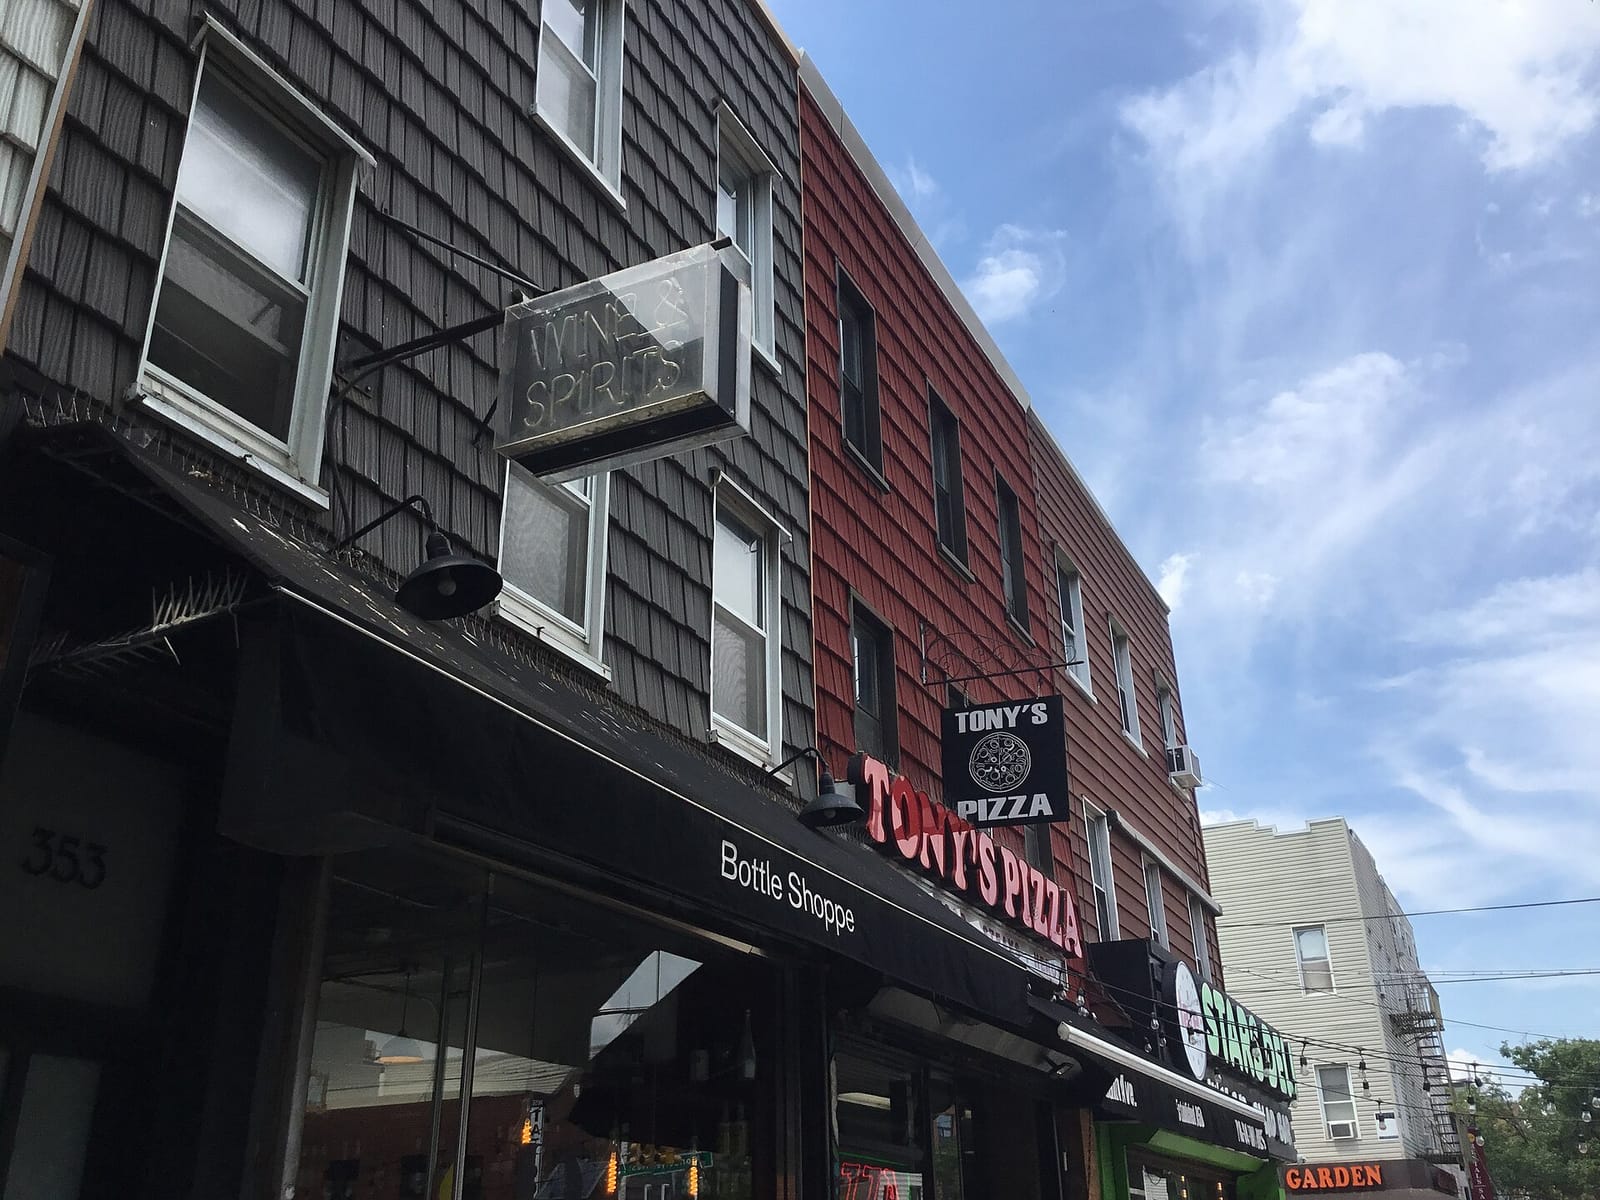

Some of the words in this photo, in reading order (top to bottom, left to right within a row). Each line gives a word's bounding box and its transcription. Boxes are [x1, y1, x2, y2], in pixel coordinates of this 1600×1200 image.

[523, 340, 685, 427] SPIRITS
[955, 702, 1048, 734] TONY'S
[957, 793, 1053, 823] PIZZA
[21, 826, 109, 890] 353
[721, 840, 783, 900] Bottle
[787, 871, 856, 936] Shoppe
[863, 755, 998, 907] TONY'S
[1000, 845, 1083, 959] PIZZA
[1285, 1164, 1383, 1189] GARDEN
